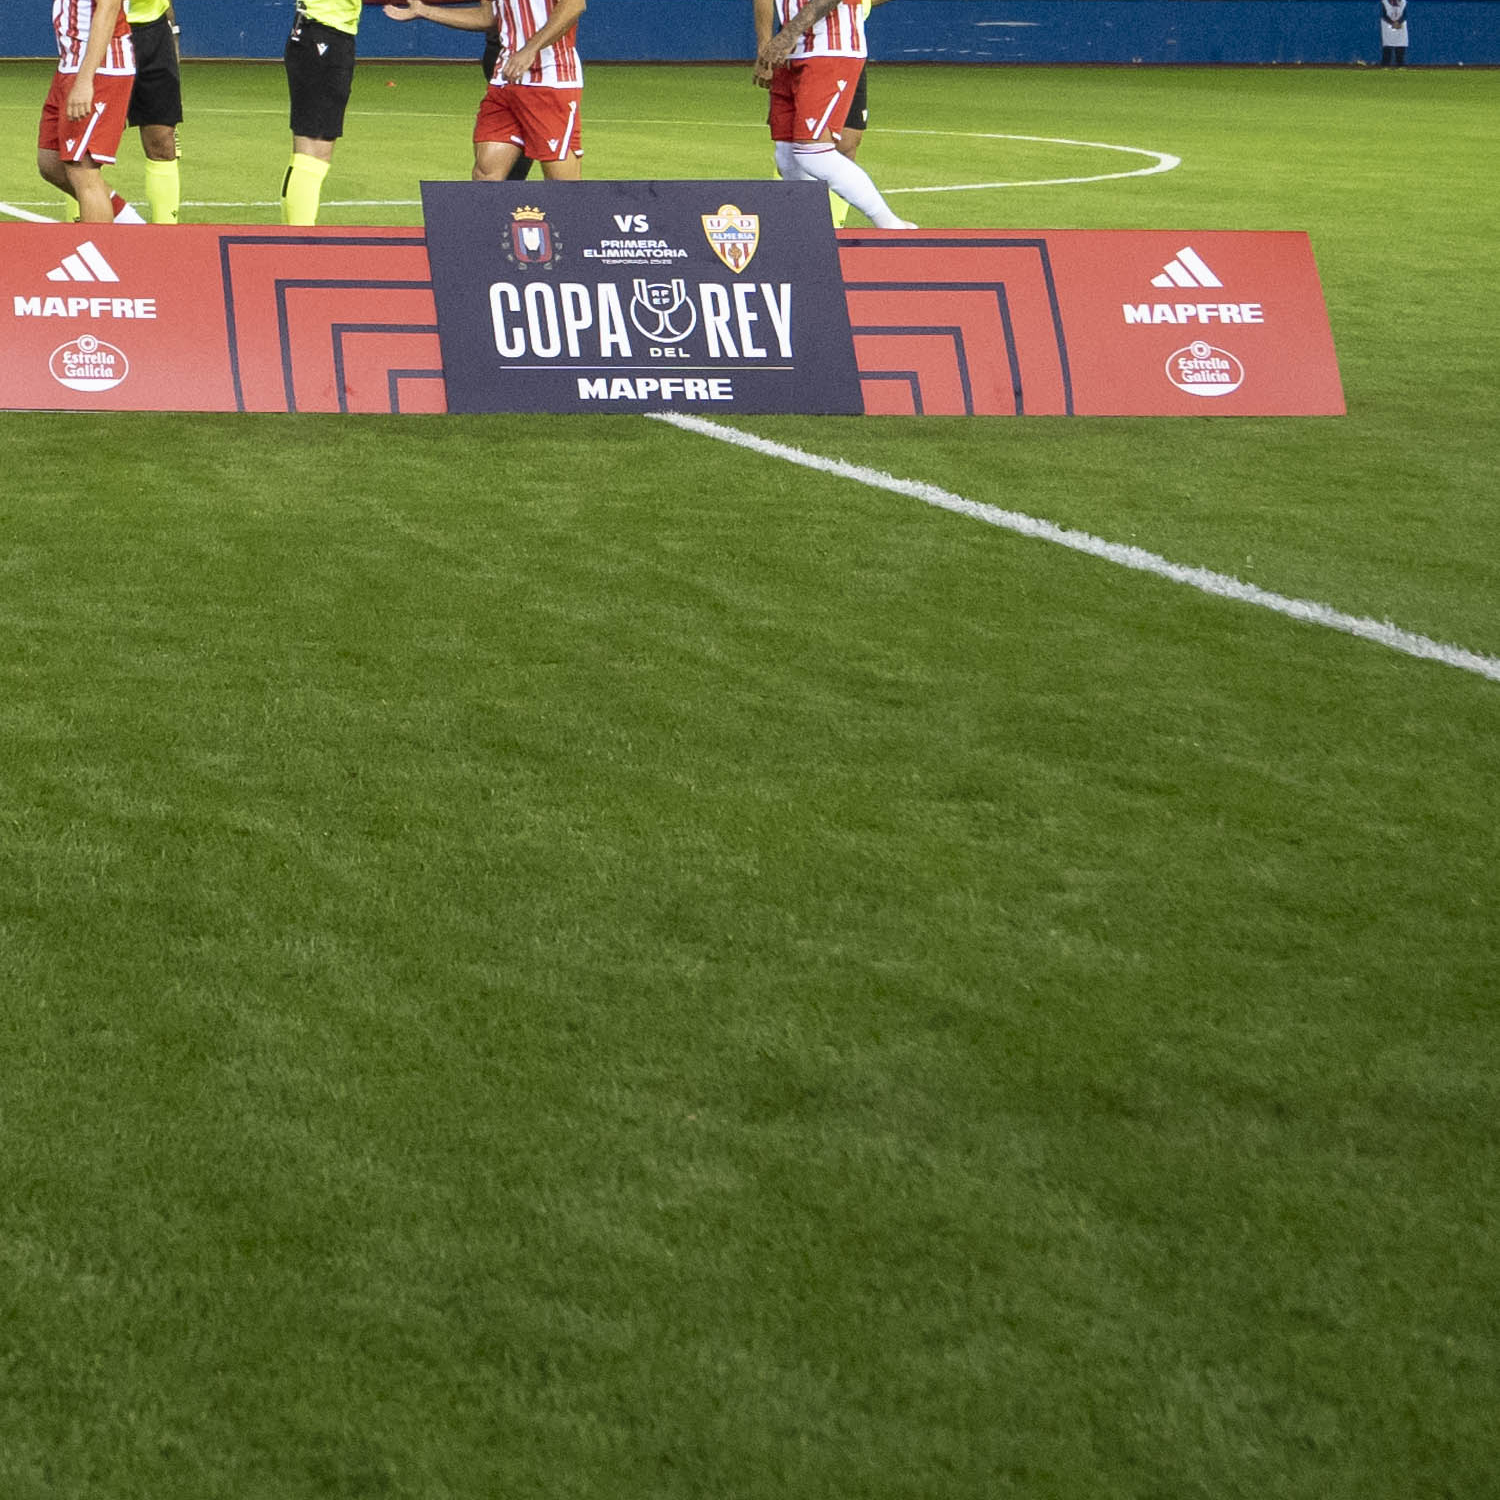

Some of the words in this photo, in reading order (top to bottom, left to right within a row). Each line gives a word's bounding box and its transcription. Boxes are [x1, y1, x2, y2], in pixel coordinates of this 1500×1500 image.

[613, 214, 650, 233] VS
[711, 232, 755, 241] ALMERIA
[600, 239, 669, 249] PRIMERA
[583, 248, 689, 259] ELIMINATORIA
[13, 296, 158, 319] MAPFRE
[1122, 303, 1265, 324] MAPFRE
[489, 281, 633, 359] COPA
[698, 282, 794, 359] REY
[62, 351, 116, 365] Estrella
[650, 347, 690, 358] DEL
[64, 363, 114, 378] Galicia
[1178, 357, 1230, 370] Estrella
[1181, 369, 1231, 383] Galicia
[576, 377, 734, 400] MAPFRE
